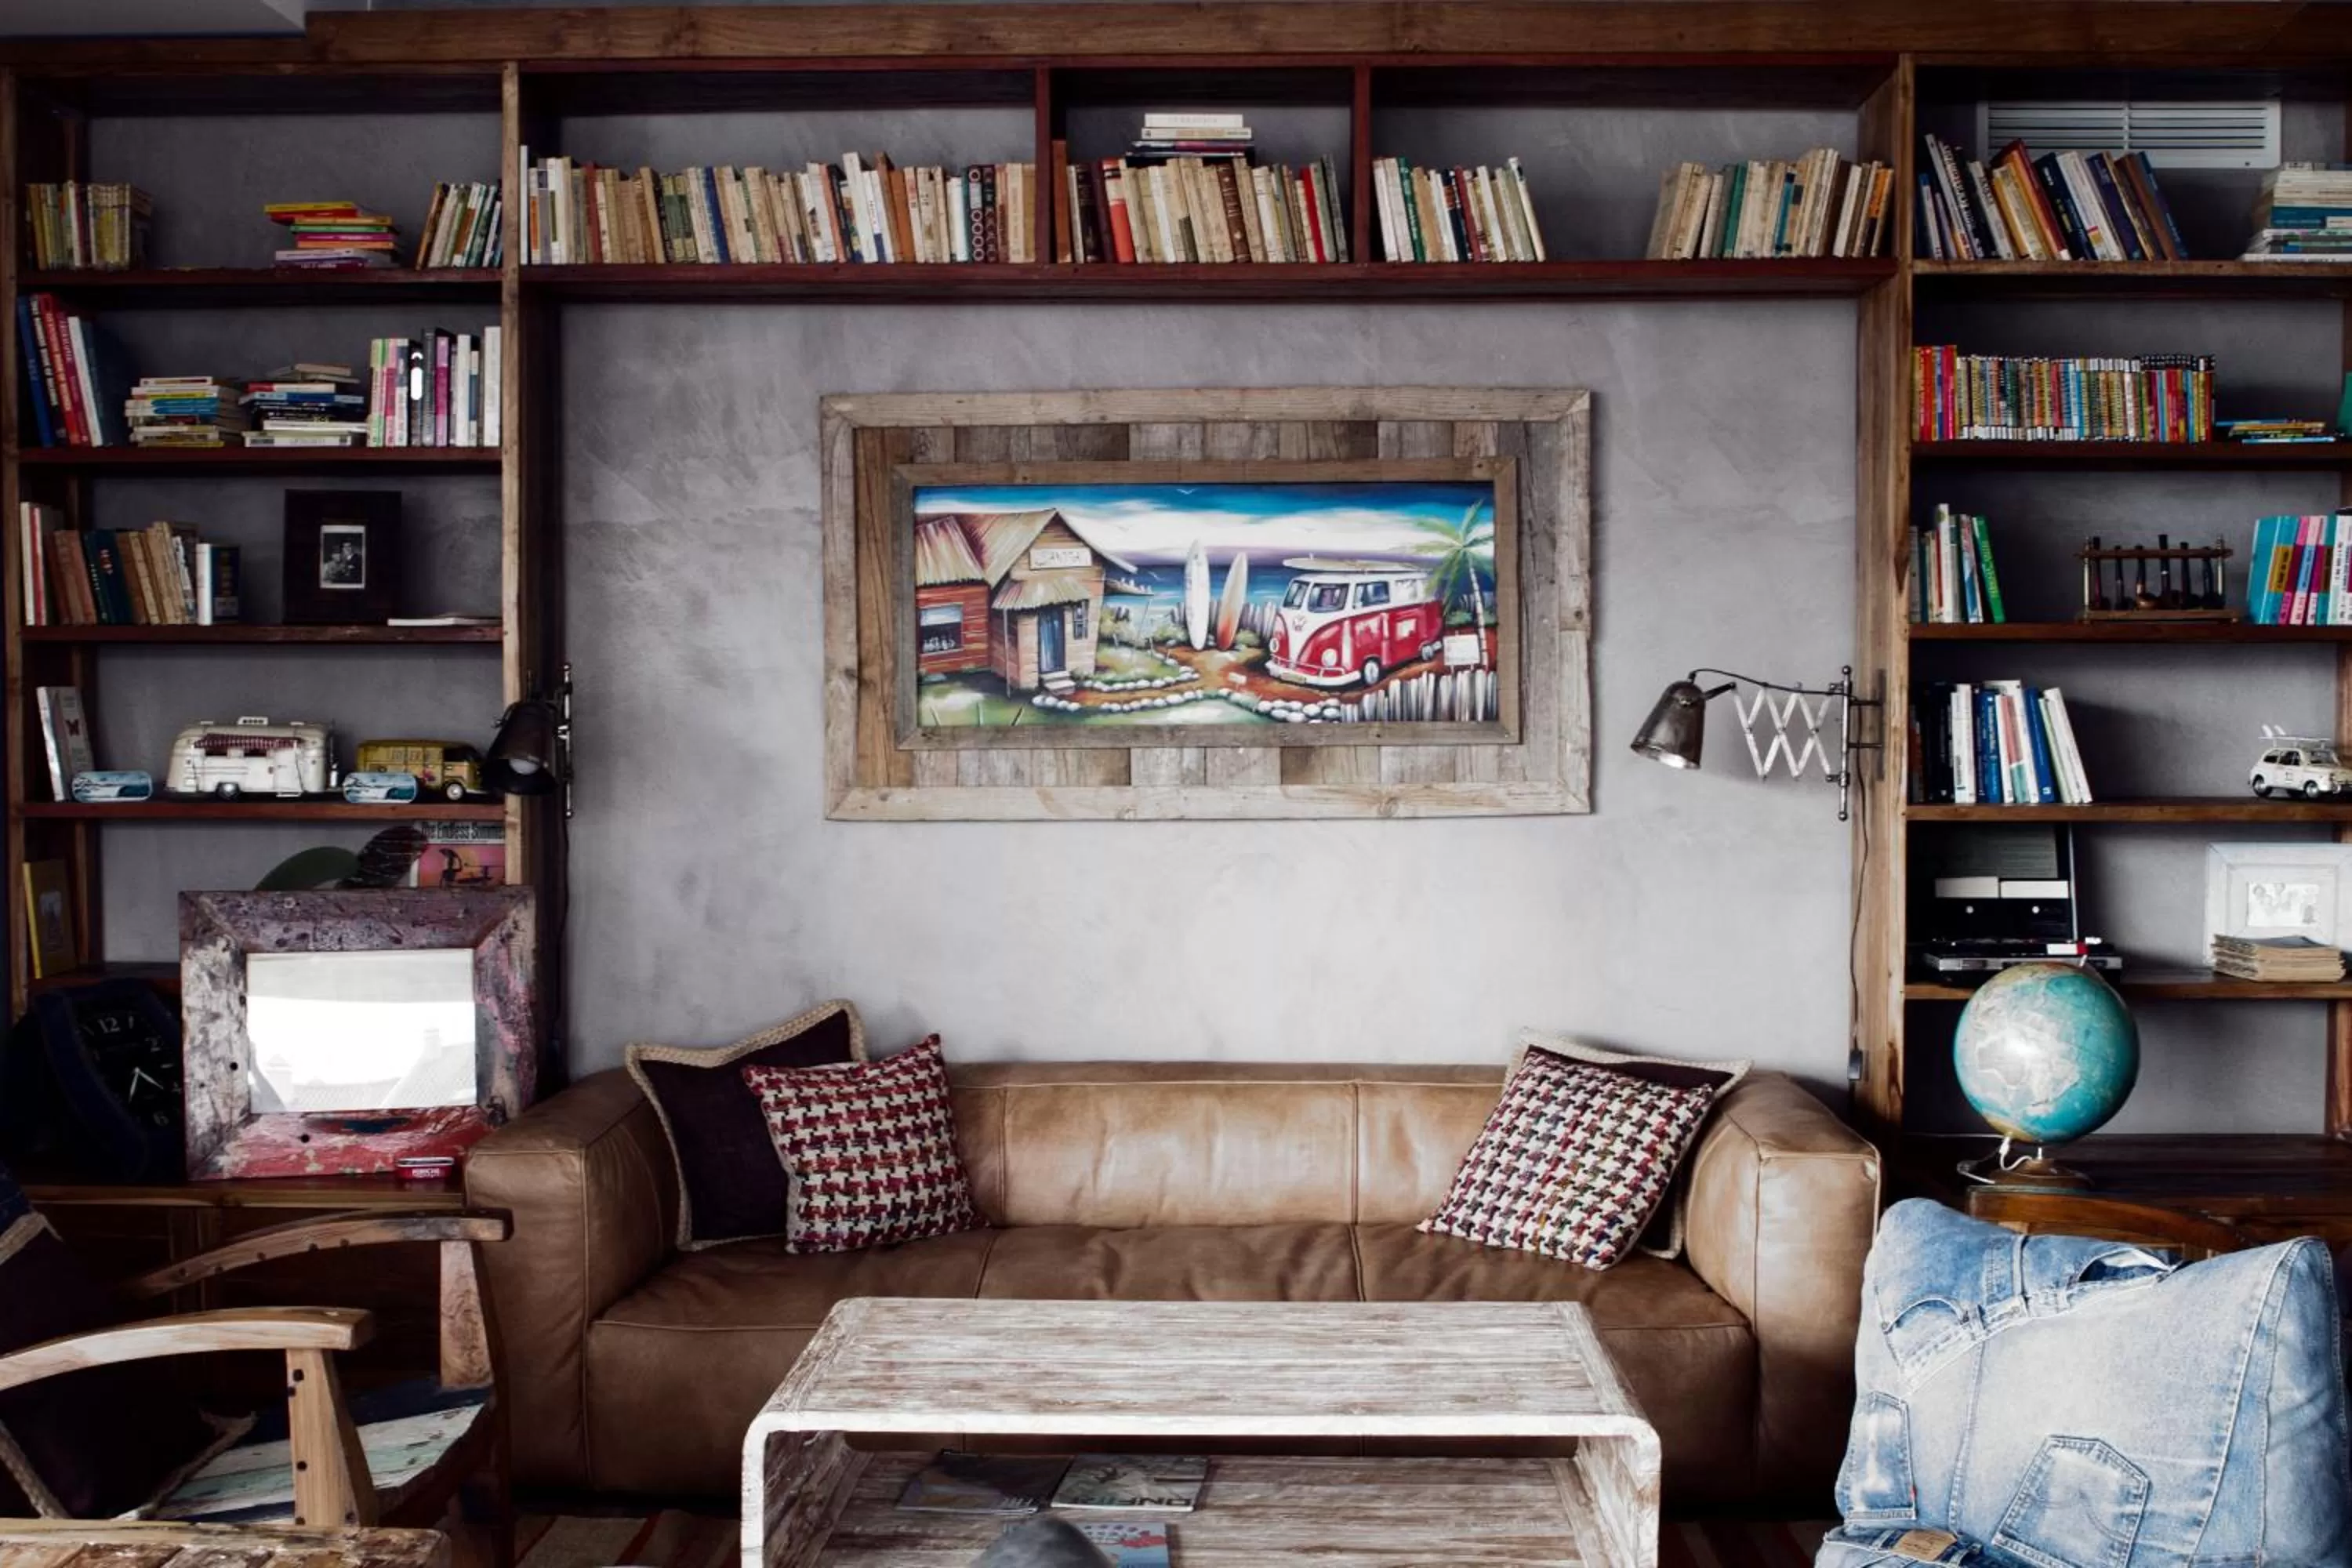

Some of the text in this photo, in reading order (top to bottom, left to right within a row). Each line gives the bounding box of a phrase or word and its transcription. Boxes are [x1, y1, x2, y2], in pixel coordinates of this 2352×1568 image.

[437, 821, 469, 840] Endless
[470, 820, 505, 840] Summe
[98, 1017, 120, 1034] 12
